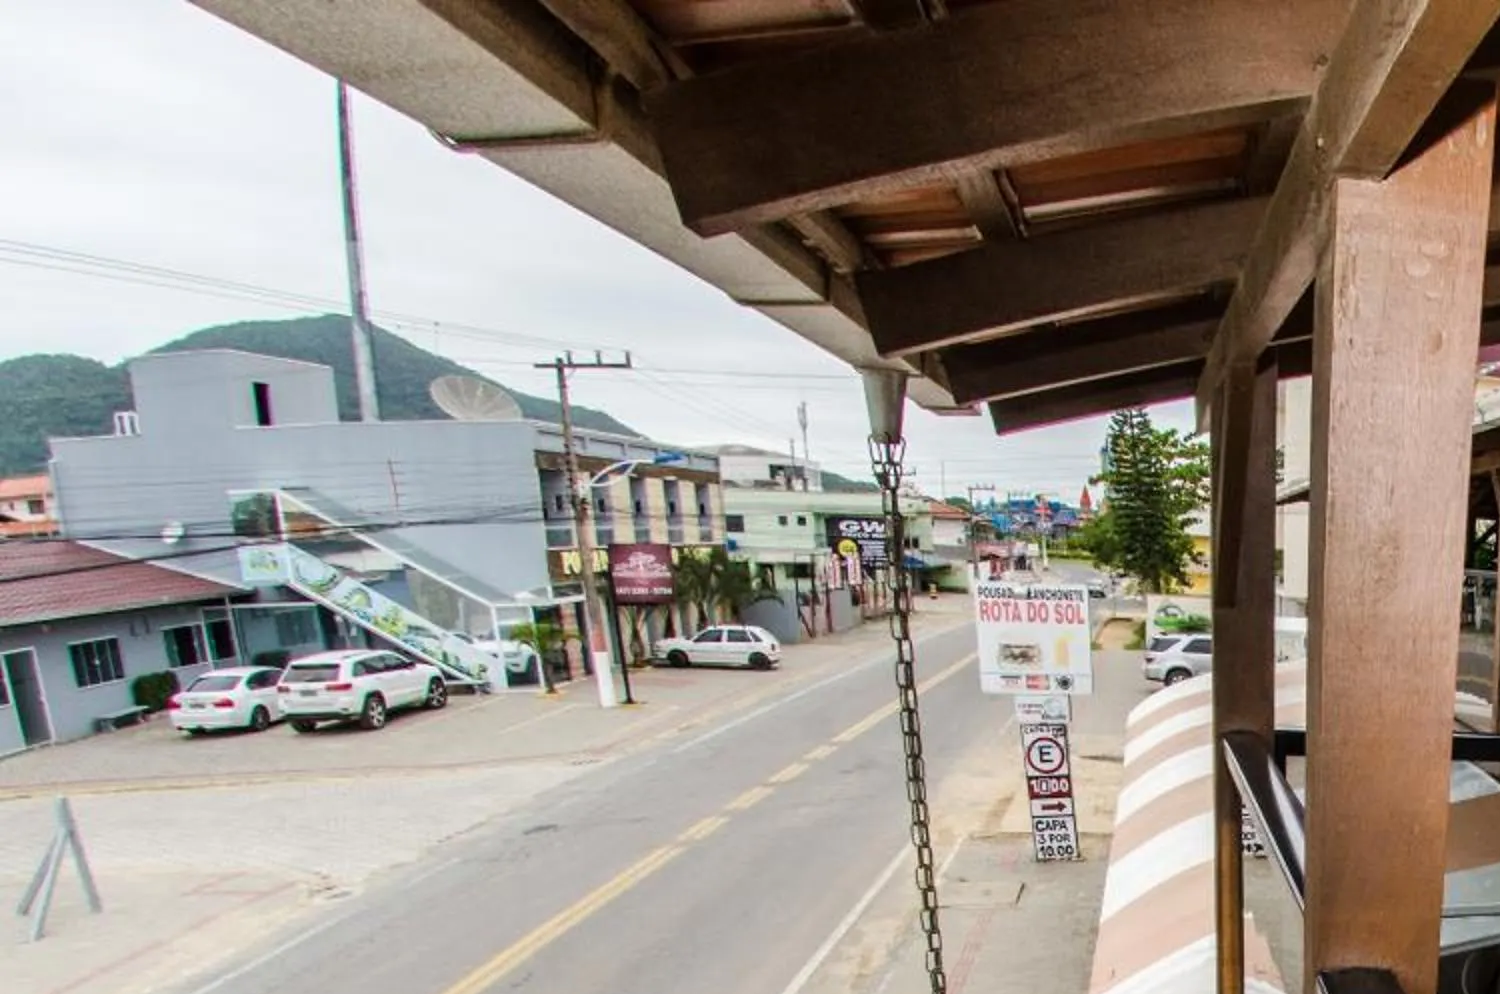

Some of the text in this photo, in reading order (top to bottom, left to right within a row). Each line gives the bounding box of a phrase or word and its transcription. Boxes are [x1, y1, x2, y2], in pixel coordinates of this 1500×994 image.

[980, 600, 1085, 624] ROTA DO SOL
[1038, 745, 1054, 763] E
[1035, 819, 1069, 832] CAPA
[1047, 833, 1071, 844] POR
